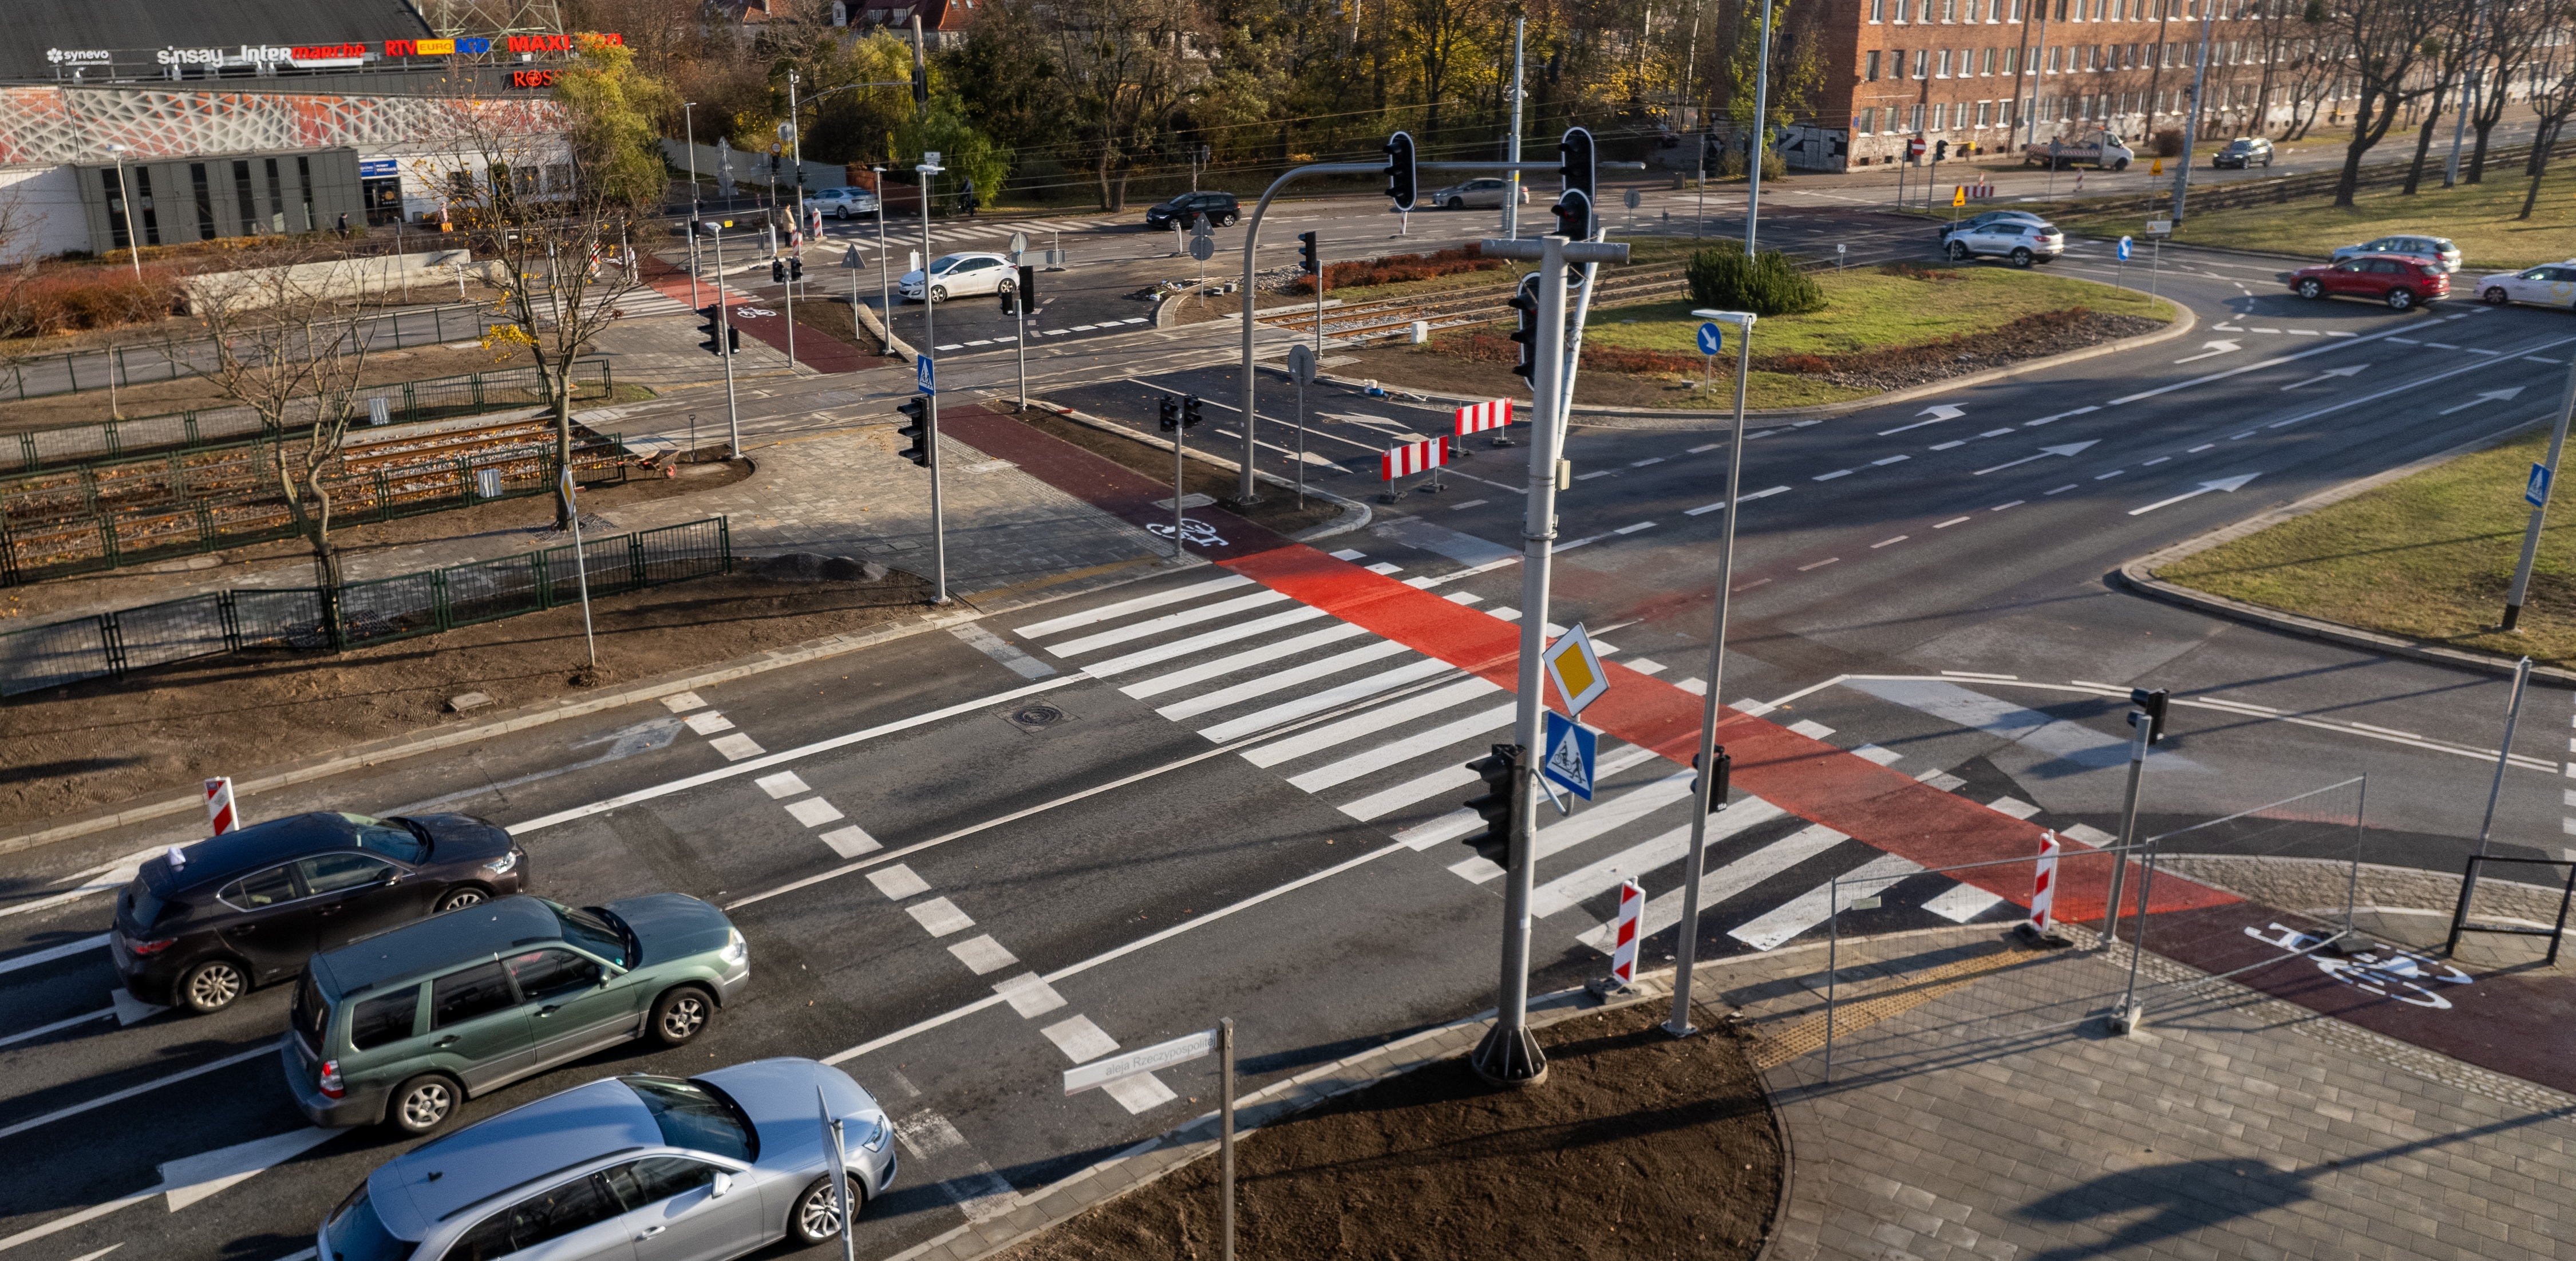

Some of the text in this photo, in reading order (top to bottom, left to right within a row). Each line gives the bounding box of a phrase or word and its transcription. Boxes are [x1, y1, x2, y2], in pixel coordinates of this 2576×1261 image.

[385, 39, 417, 56] RTV
[456, 37, 489, 53] AGD
[508, 34, 570, 52] MAXI
[64, 50, 109, 61] synevo
[157, 46, 223, 68] sinsay
[1106, 1038, 1216, 1076] aleja Rzeczypospolitej
